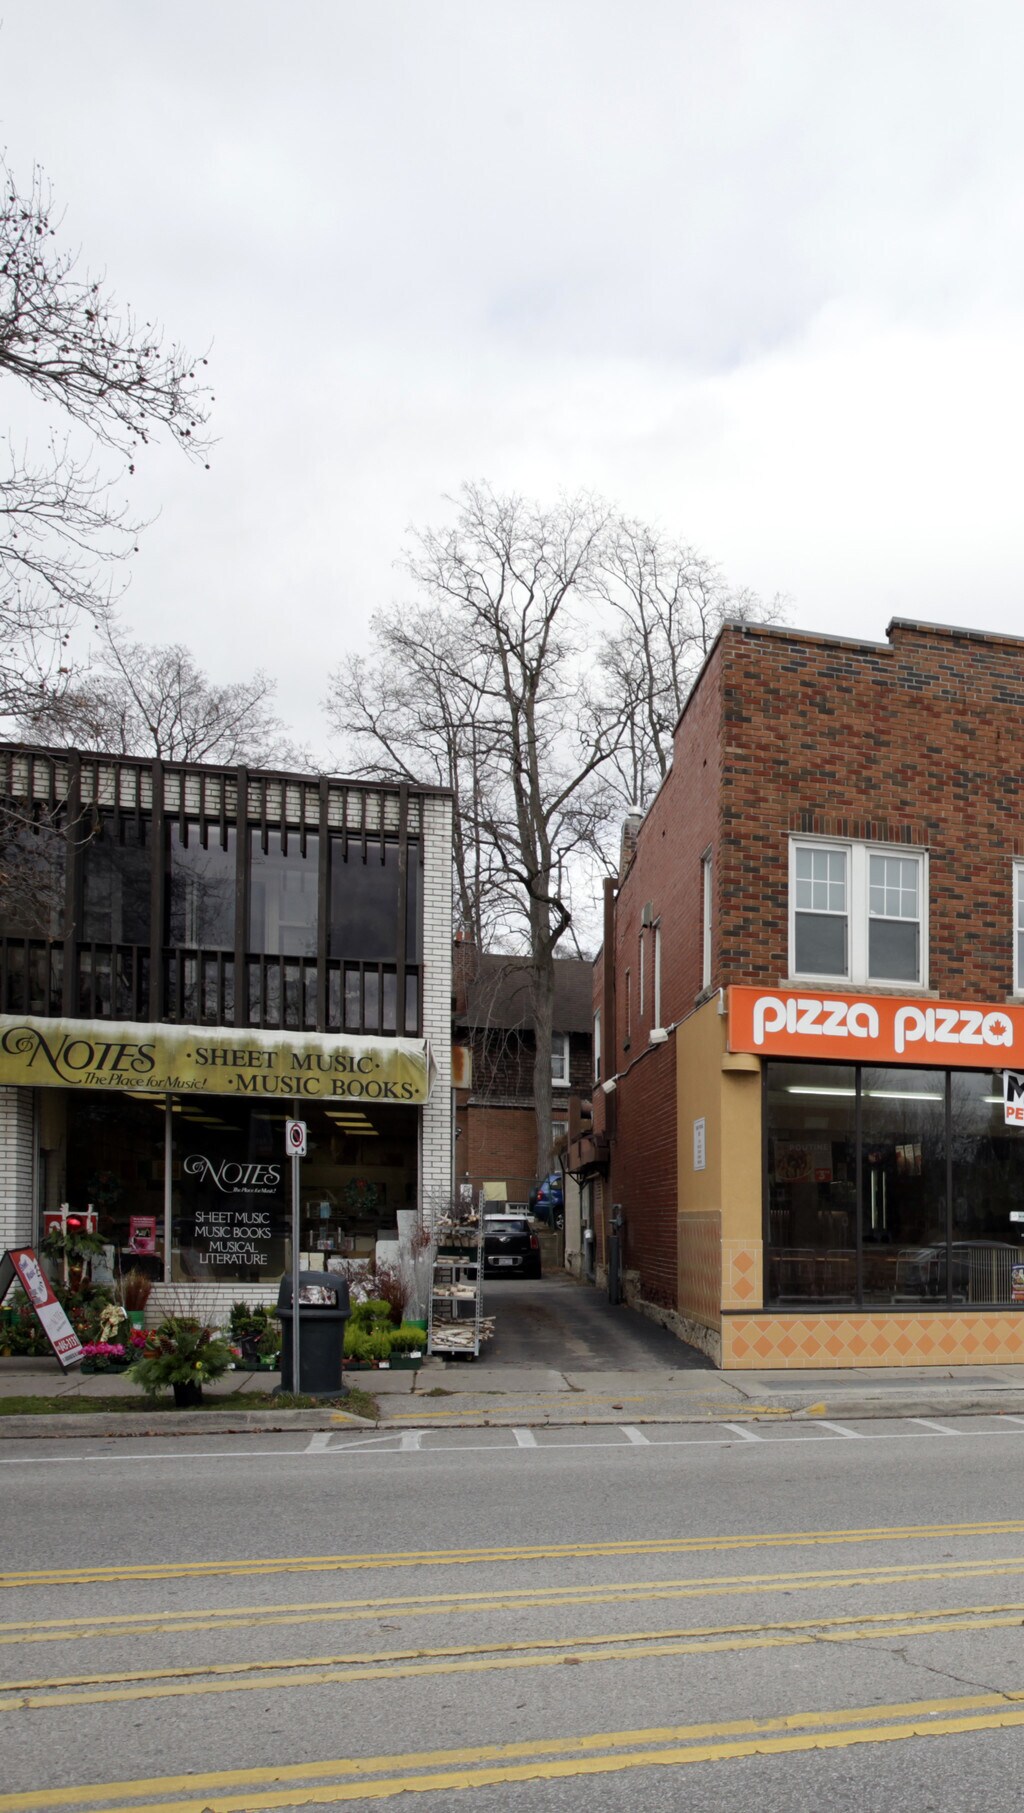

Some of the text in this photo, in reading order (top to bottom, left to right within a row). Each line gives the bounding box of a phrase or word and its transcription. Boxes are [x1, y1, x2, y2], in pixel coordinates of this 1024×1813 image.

[195, 1048, 373, 1073] SHEET MUSIC
[84, 1072, 207, 1089] The Place for Music!
[236, 1073, 413, 1099] MUSIC BOOKS
[195, 1211, 270, 1224] SHEET MUSIC
[194, 1226, 272, 1239] MUSIC BOOKS
[209, 1241, 258, 1253] MUSICAL
[200, 1253, 267, 1265] LITERATURE
